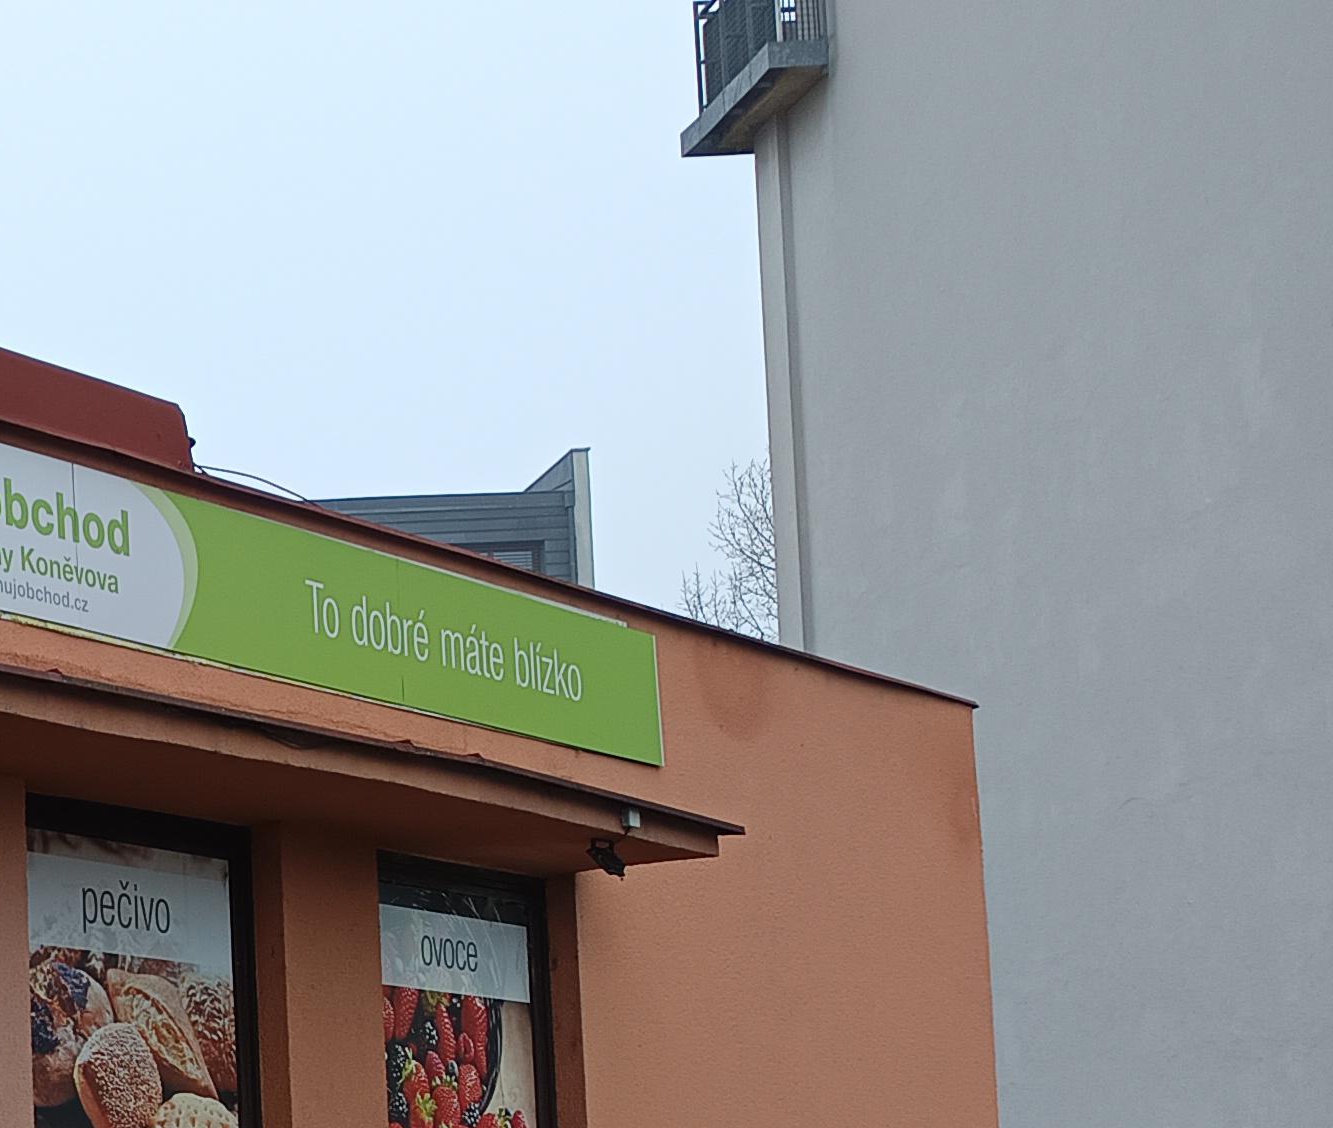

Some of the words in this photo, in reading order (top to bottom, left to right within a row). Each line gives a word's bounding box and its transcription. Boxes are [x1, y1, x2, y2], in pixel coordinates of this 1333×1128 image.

[21, 537, 119, 594] Koněvova
[304, 578, 340, 639] To
[351, 596, 429, 662] dobré
[441, 624, 505, 681] máte
[514, 637, 582, 702] blízko
[81, 879, 171, 935] pečivo
[420, 933, 479, 973] ovoce
